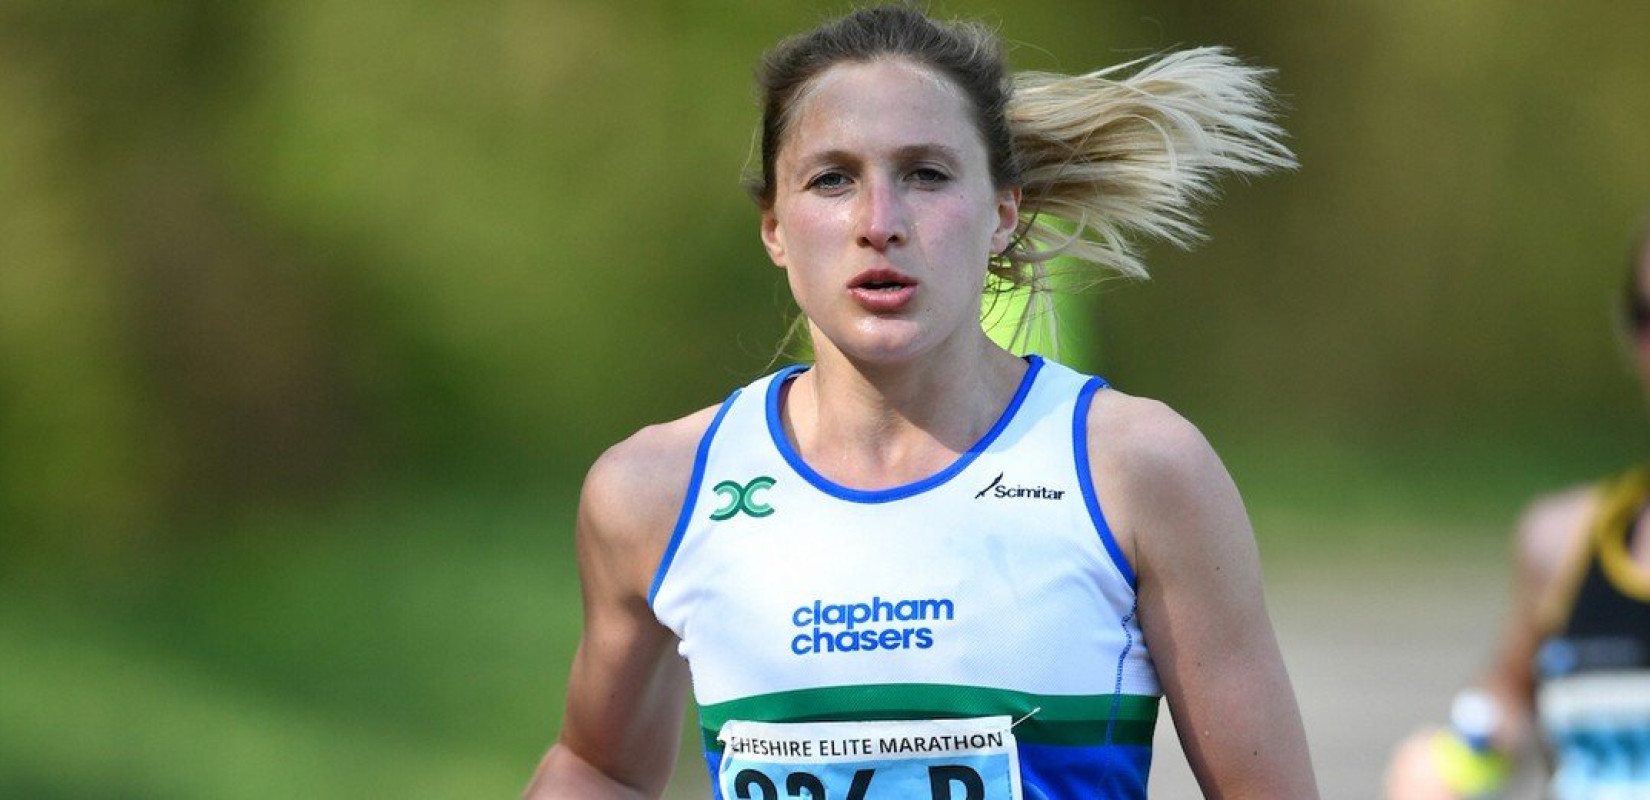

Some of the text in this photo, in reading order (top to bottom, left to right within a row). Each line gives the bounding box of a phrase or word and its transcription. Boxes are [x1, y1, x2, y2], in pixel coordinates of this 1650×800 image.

[994, 484, 1065, 501] Scimitar
[792, 597, 954, 629] clapham
[791, 627, 934, 655] chasers
[819, 738, 872, 756] ELITE
[879, 732, 1003, 754] MARATHON
